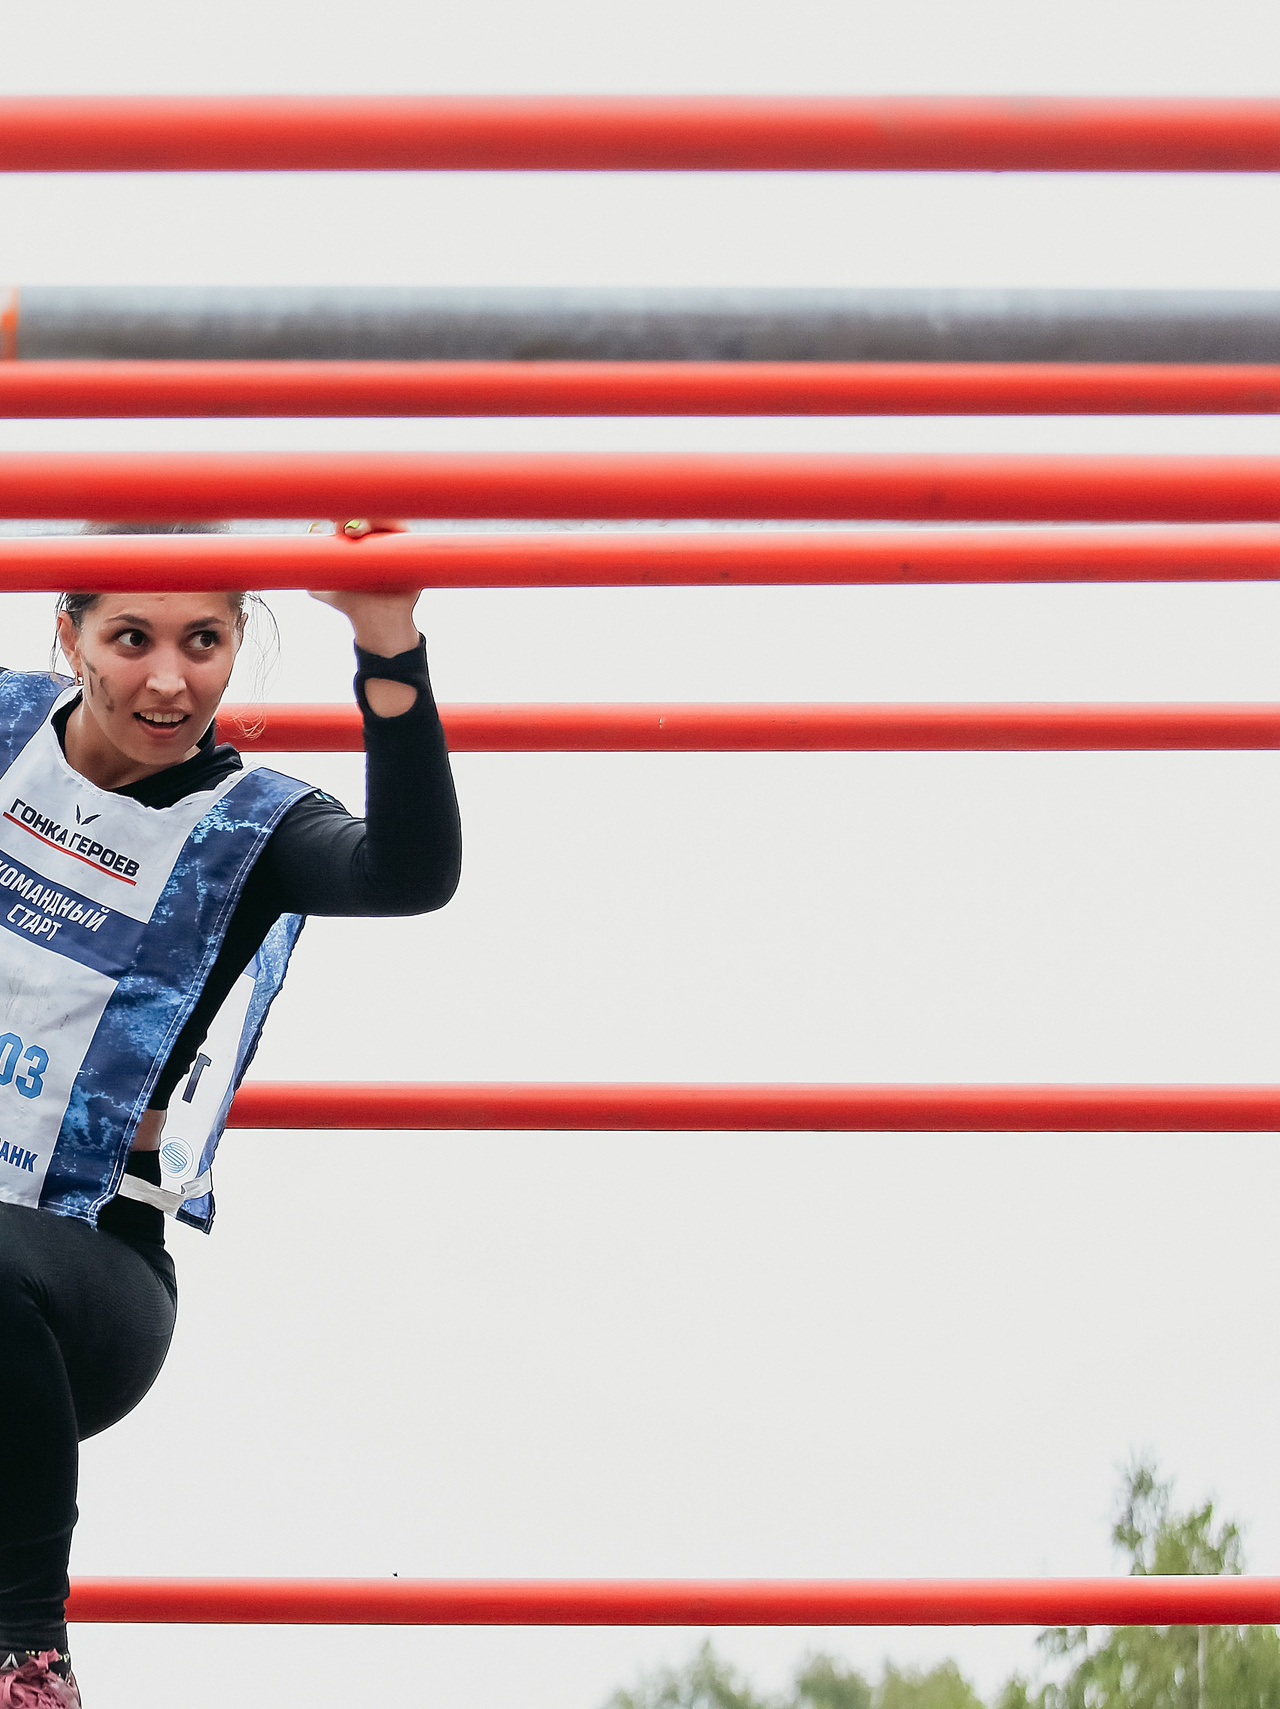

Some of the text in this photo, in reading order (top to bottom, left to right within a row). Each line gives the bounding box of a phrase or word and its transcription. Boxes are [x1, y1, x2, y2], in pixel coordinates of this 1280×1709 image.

[10, 798, 140, 877] ГОНКА ГЕРОЕВ
[6, 903, 62, 941] СТАРТ
